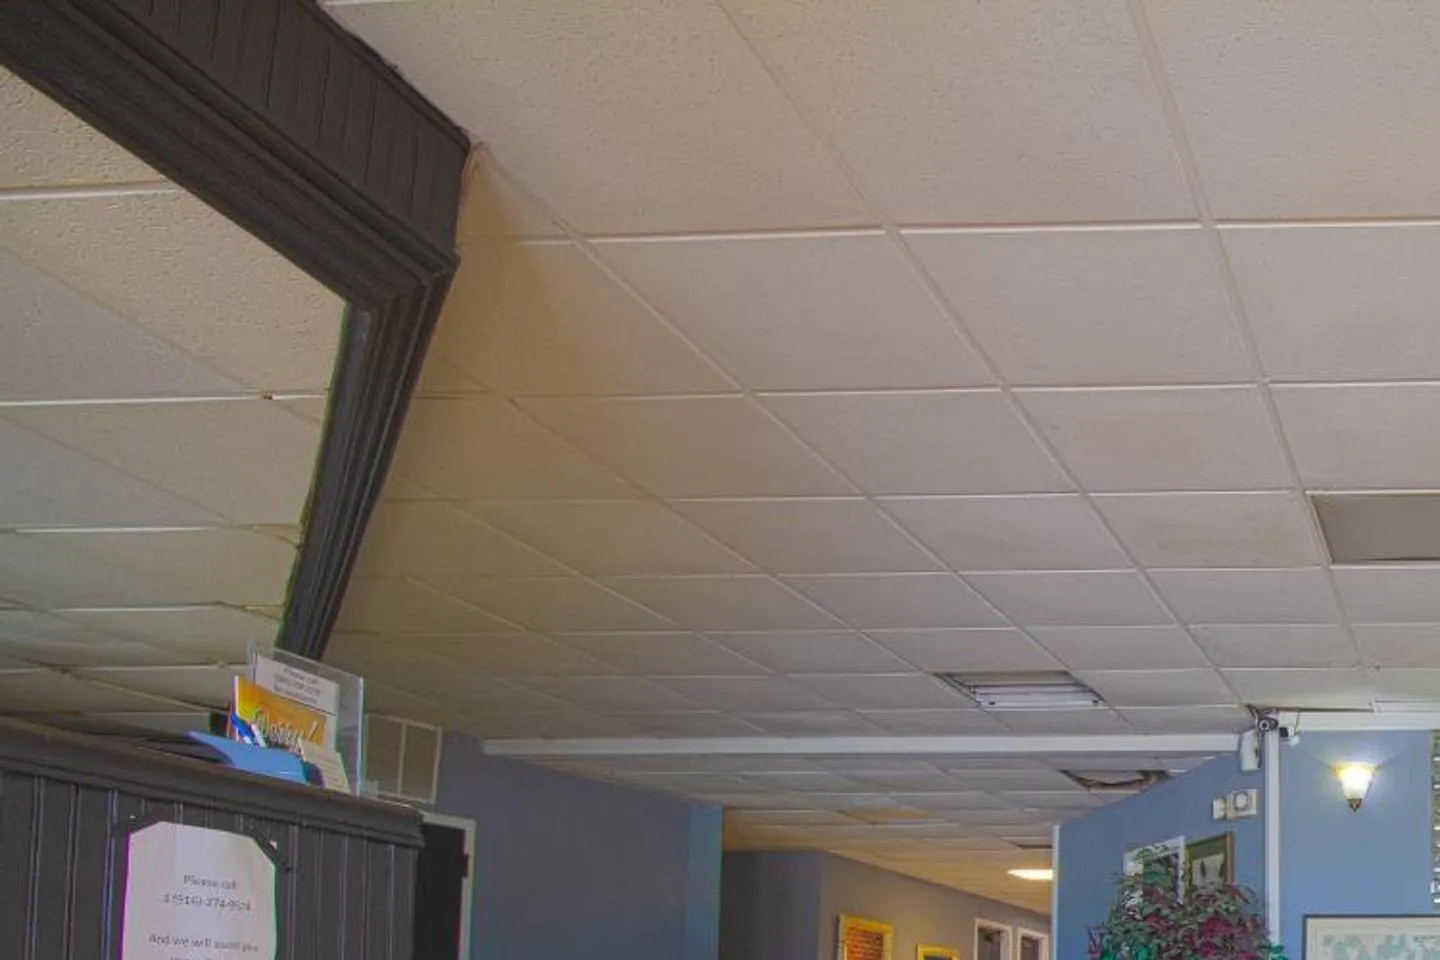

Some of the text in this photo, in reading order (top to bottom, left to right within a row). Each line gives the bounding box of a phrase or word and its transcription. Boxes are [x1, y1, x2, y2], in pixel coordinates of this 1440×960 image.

[183, 874, 219, 888] Please
[148, 933, 170, 945] And
[172, 937, 190, 947] we
